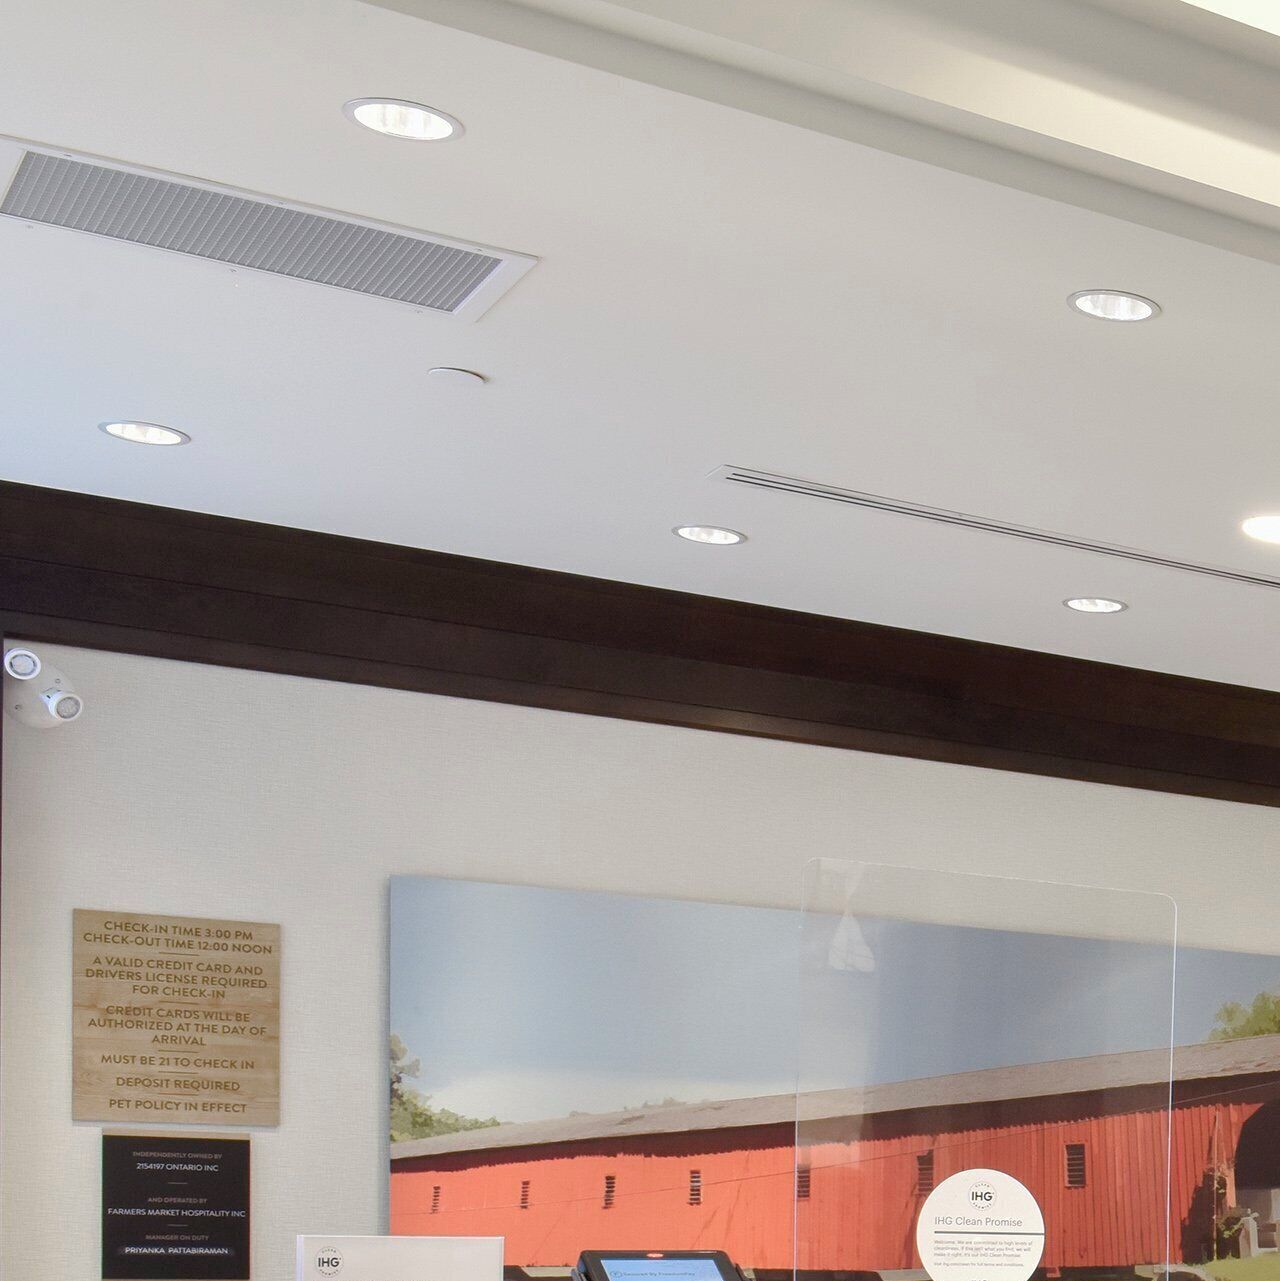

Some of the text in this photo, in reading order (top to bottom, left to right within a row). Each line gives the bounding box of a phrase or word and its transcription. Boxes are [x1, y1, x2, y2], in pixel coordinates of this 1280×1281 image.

[104, 921, 253, 940] CHECK-IN TIME 3:00 PM
[83, 933, 272, 955] CHECK-OUT TIME 12:00 NOON
[93, 956, 263, 976] A VALID CREDIT CARD AND
[85, 968, 267, 989] DRIVERS LICENSE REQUIRED
[132, 985, 226, 999] FOR CHECK-IN
[106, 1005, 250, 1022] CREDIT CARDS WILL BE
[88, 1018, 267, 1036] AUTHORIZED AT THE DAY OF
[152, 1035, 206, 1046] ARRIVAL
[101, 1054, 254, 1069] MUST BE 21 TO CHECK IN
[116, 1077, 241, 1092] DEPOSIT REQUIRED
[109, 1099, 247, 1113] PET POLICY IN EFFECT
[971, 1191, 993, 1201] IHG
[108, 1208, 146, 1216] FARMERS
[181, 1209, 230, 1217] HOSPITALITY
[231, 1210, 246, 1218] INC
[935, 1216, 1023, 1227] IHG Clean Promise
[318, 1257, 340, 1268] IHG
